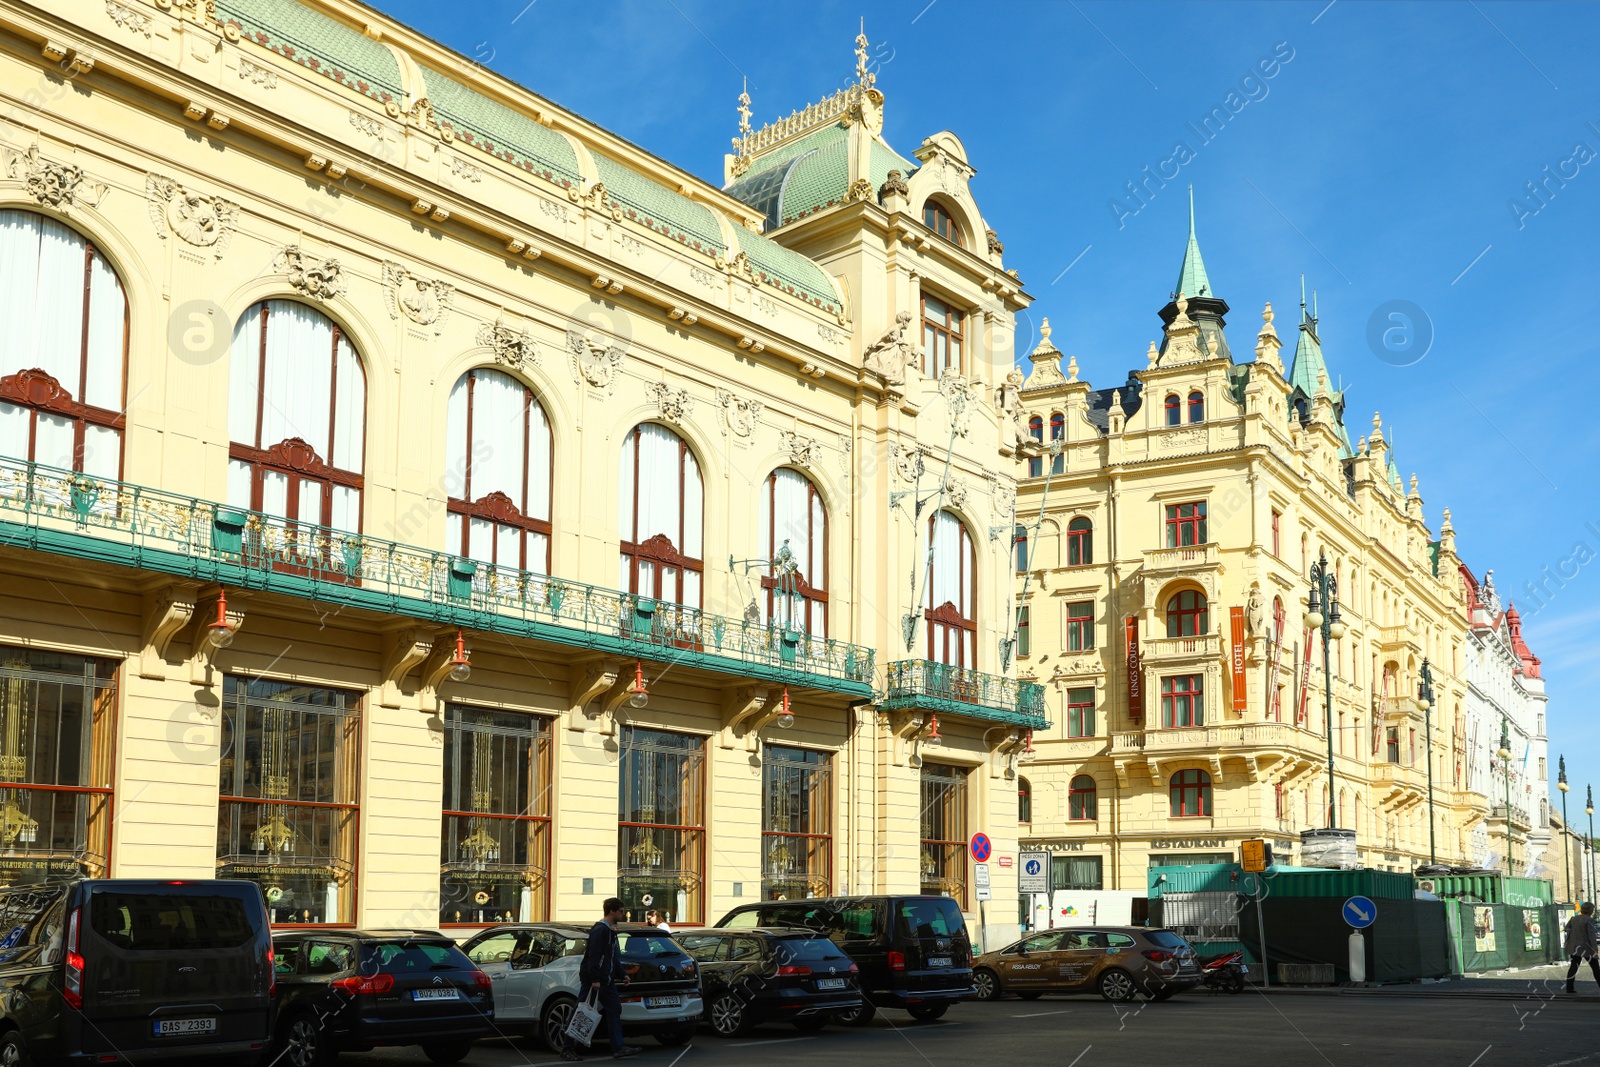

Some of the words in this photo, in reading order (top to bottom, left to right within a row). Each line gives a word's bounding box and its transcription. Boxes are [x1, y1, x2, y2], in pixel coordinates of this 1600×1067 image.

[1129, 641, 1138, 670] COURT
[1234, 642, 1243, 674] HOTEL
[1131, 672, 1139, 698] KINGS
[1020, 844, 1043, 852] NGS
[1045, 842, 1086, 851] COURT
[1150, 837, 1228, 849] RESTAURANT
[437, 989, 456, 997] 0382
[162, 1021, 181, 1032] 6AS
[187, 1019, 212, 1031] 2393
